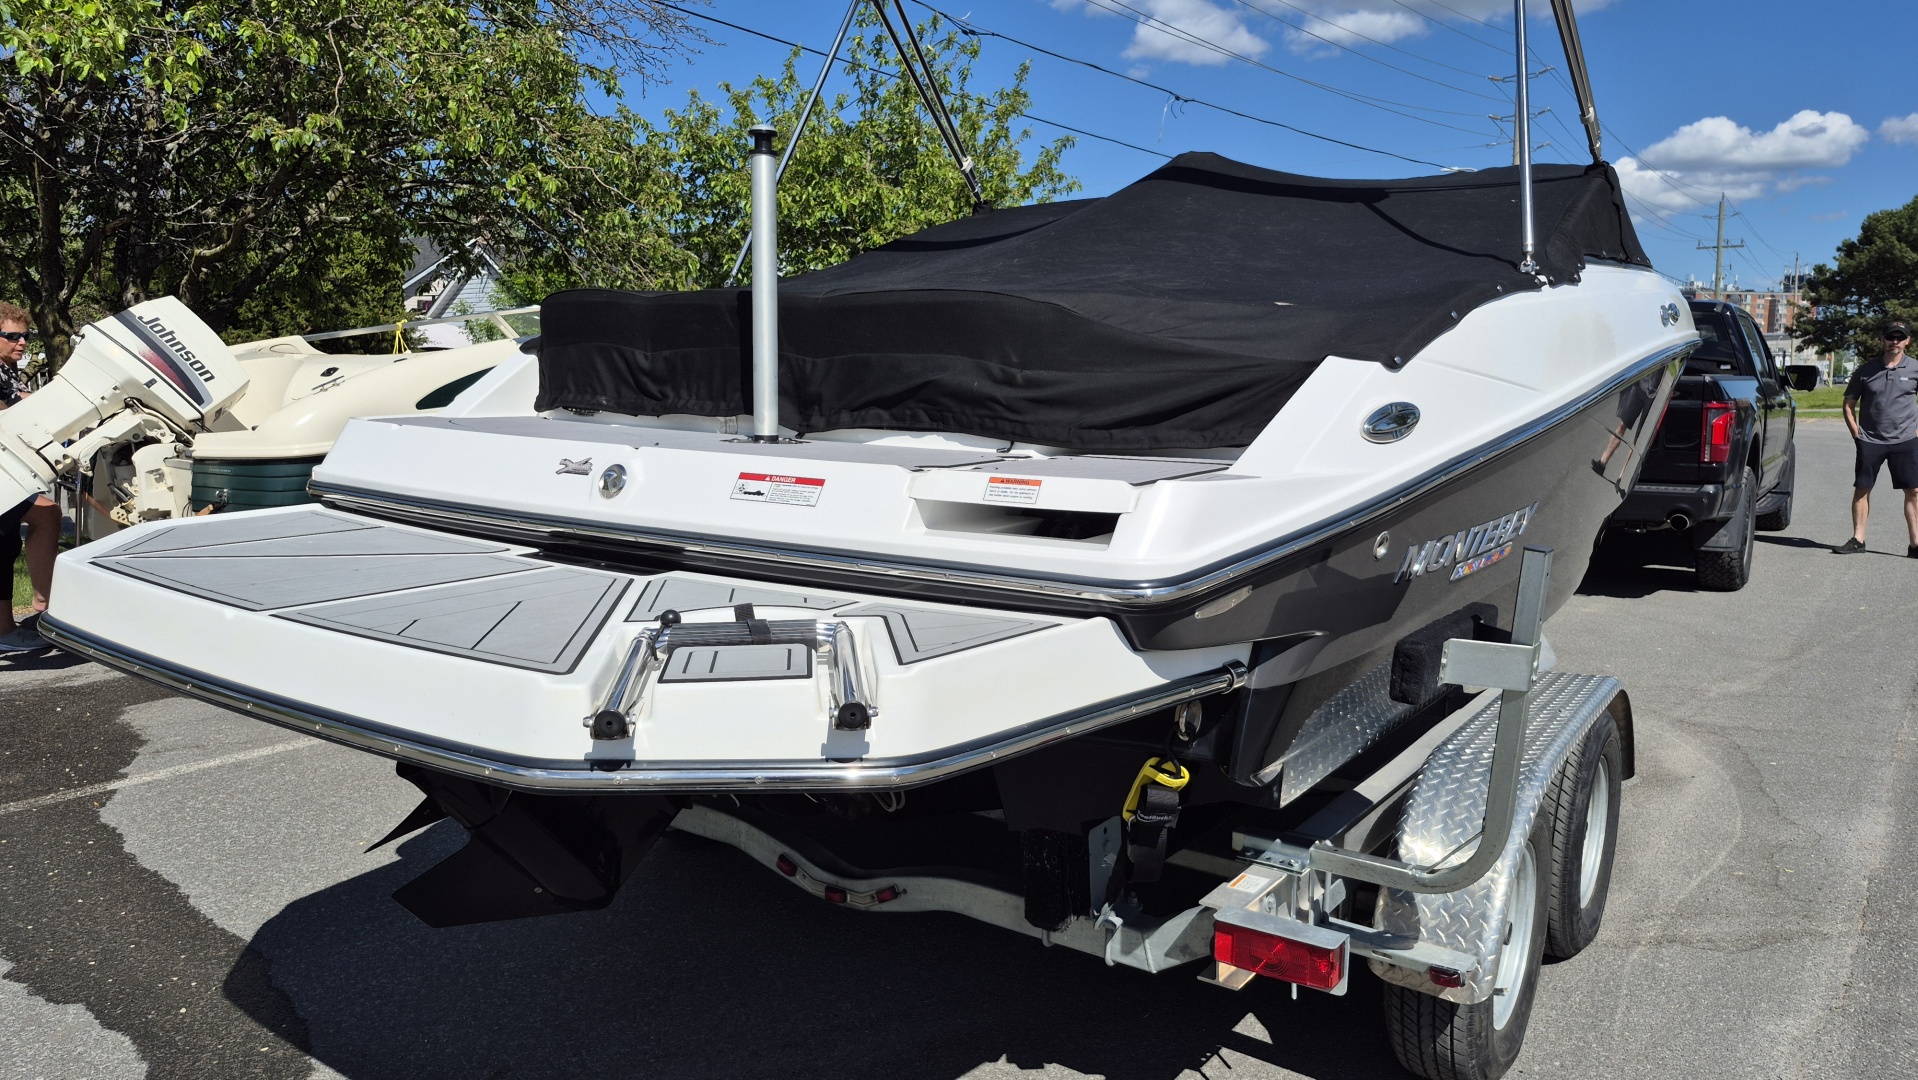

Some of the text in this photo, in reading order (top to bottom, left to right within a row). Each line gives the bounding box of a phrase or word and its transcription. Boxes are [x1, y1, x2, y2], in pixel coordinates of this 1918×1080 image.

[138, 315, 215, 383] Johnson
[771, 475, 796, 484] DANGER
[1394, 501, 1539, 584] MONTEREY
